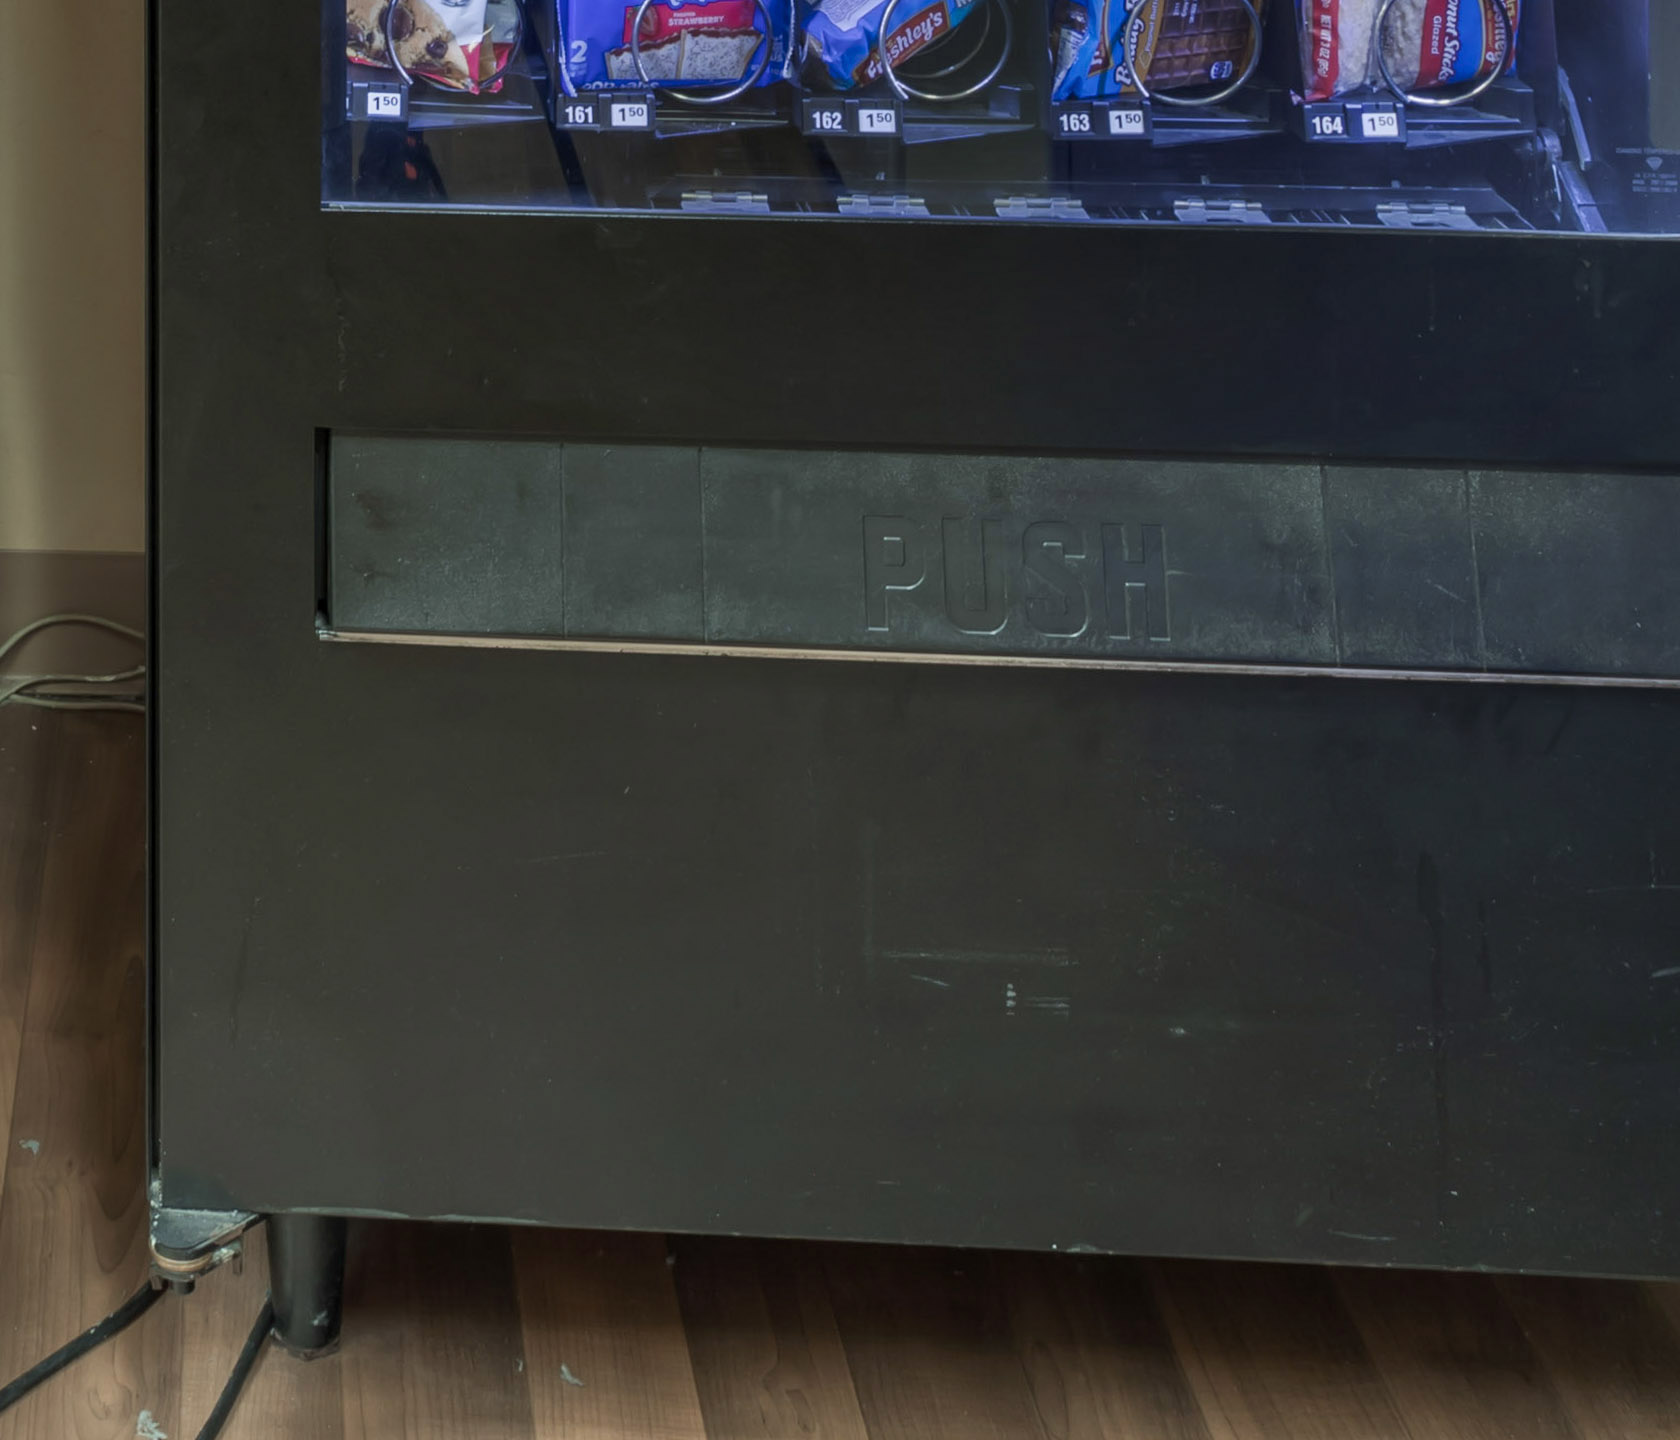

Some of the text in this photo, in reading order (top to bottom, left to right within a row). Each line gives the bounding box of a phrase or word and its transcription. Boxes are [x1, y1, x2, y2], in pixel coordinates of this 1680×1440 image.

[1431, 16, 1442, 55] Glazed
[565, 107, 593, 123] 161
[812, 113, 842, 128] 162
[1060, 115, 1089, 131] 163
[1313, 117, 1342, 134] 164
[862, 514, 1171, 645] PUSH
